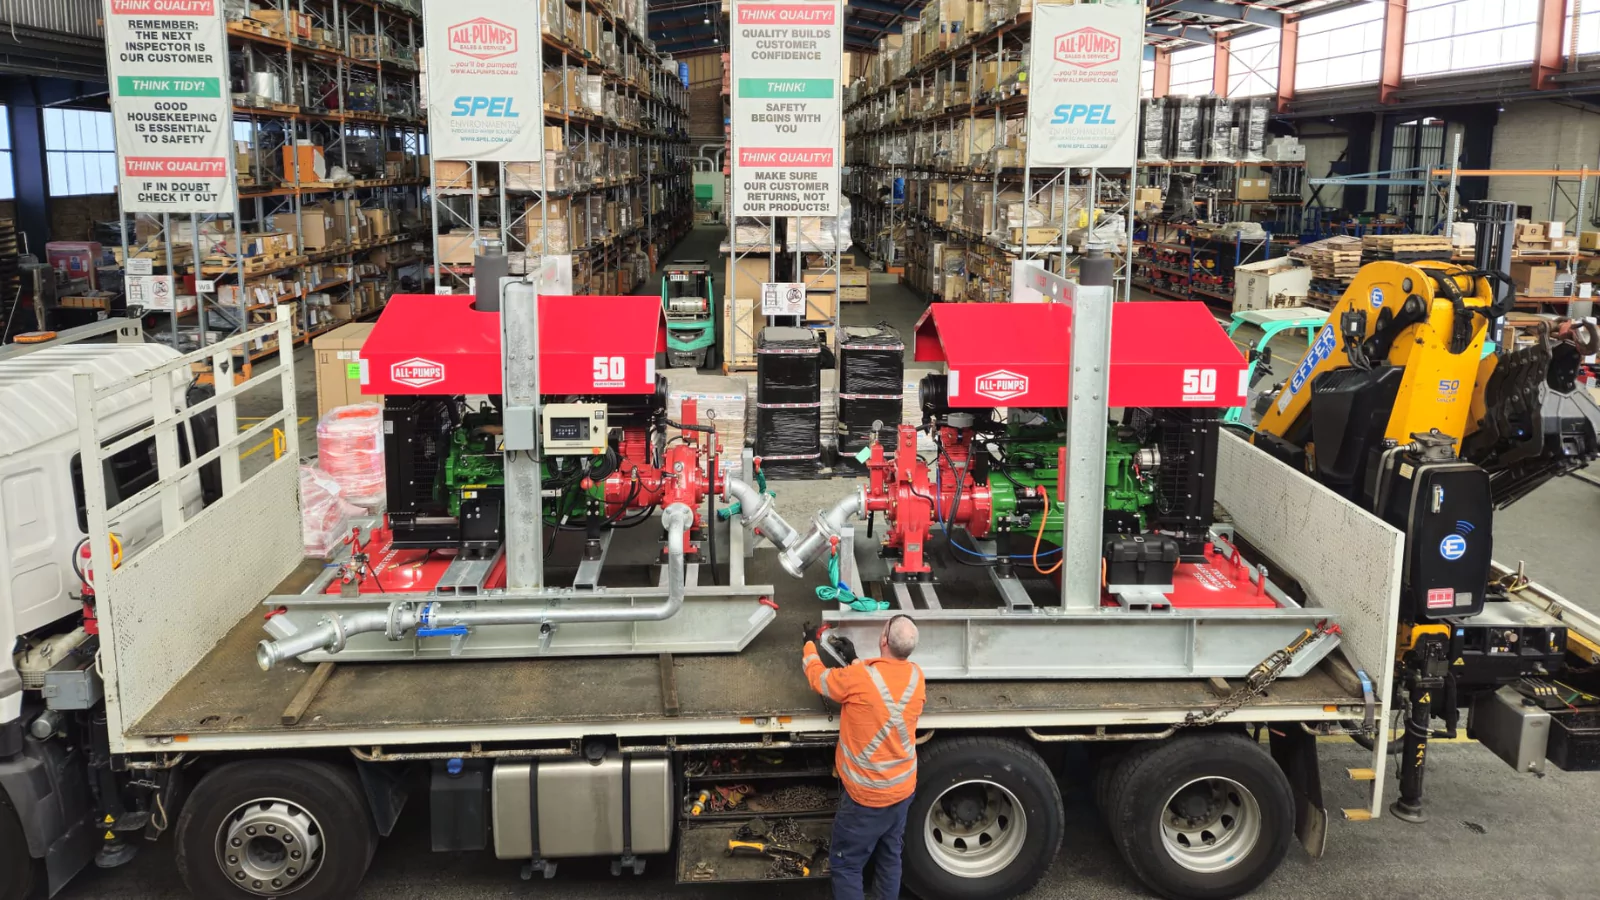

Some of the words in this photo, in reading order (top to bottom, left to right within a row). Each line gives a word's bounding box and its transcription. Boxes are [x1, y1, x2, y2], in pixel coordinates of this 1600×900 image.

[114, 0, 151, 10] THINK
[154, 0, 210, 11] QUALITY!
[741, 10, 775, 19] THINK
[780, 10, 832, 20] QUALITY!
[128, 20, 199, 30] REMEMBER:
[135, 31, 159, 40] THE
[162, 32, 192, 41] NEXT
[742, 29, 788, 38] QUALITY
[792, 30, 831, 38] BUILDS
[125, 42, 191, 52] INSPECTOR
[194, 43, 205, 52] IS
[756, 40, 817, 49] CUSTOMER
[120, 53, 144, 62] OUR
[147, 54, 213, 63] CUSTOMER
[751, 51, 821, 60] CONFIDENCE
[133, 80, 169, 90] THINK
[173, 81, 205, 91] TIDY!
[768, 82, 805, 92] THINK!
[154, 102, 187, 111] GOOD
[451, 96, 520, 117] SPEL
[766, 103, 807, 112] SAFETY
[127, 113, 217, 122] HOUSEKEEPING
[751, 114, 791, 122] BEGINS
[794, 114, 821, 122] WITH
[1050, 104, 1116, 124] SPEL
[135, 124, 146, 132] IS
[149, 124, 211, 133] ESSENTIAL
[451, 120, 520, 128] ENVIRONMENTAL
[775, 124, 797, 133] YOU
[142, 135, 158, 143] TO
[162, 135, 205, 144] SAFETY
[741, 153, 776, 162] THINK
[779, 153, 830, 162] QUALITY!
[127, 161, 163, 171] THINK
[166, 162, 223, 171] QUALITY!
[755, 172, 786, 180] MAKE
[789, 172, 817, 180] SURE
[143, 183, 153, 191] IF
[156, 183, 168, 191] IN
[171, 183, 210, 192] DOUBT
[744, 182, 767, 191] OUR
[770, 182, 829, 191] CUSTOMER
[138, 193, 177, 203] CHECK
[180, 194, 191, 202] IT
[194, 194, 217, 202] OUT
[747, 193, 800, 202] RETURNS,
[803, 193, 825, 201] NOT
[743, 203, 766, 211] OUR
[769, 203, 830, 211] PRODUCTS!
[1292, 326, 1334, 391] EFFER
[395, 367, 441, 378] ALL-PUMPS
[593, 356, 625, 380] 50
[979, 380, 1025, 390] ALL-PUMPS
[1183, 369, 1217, 394] 50
[1439, 379, 1460, 390] 50
